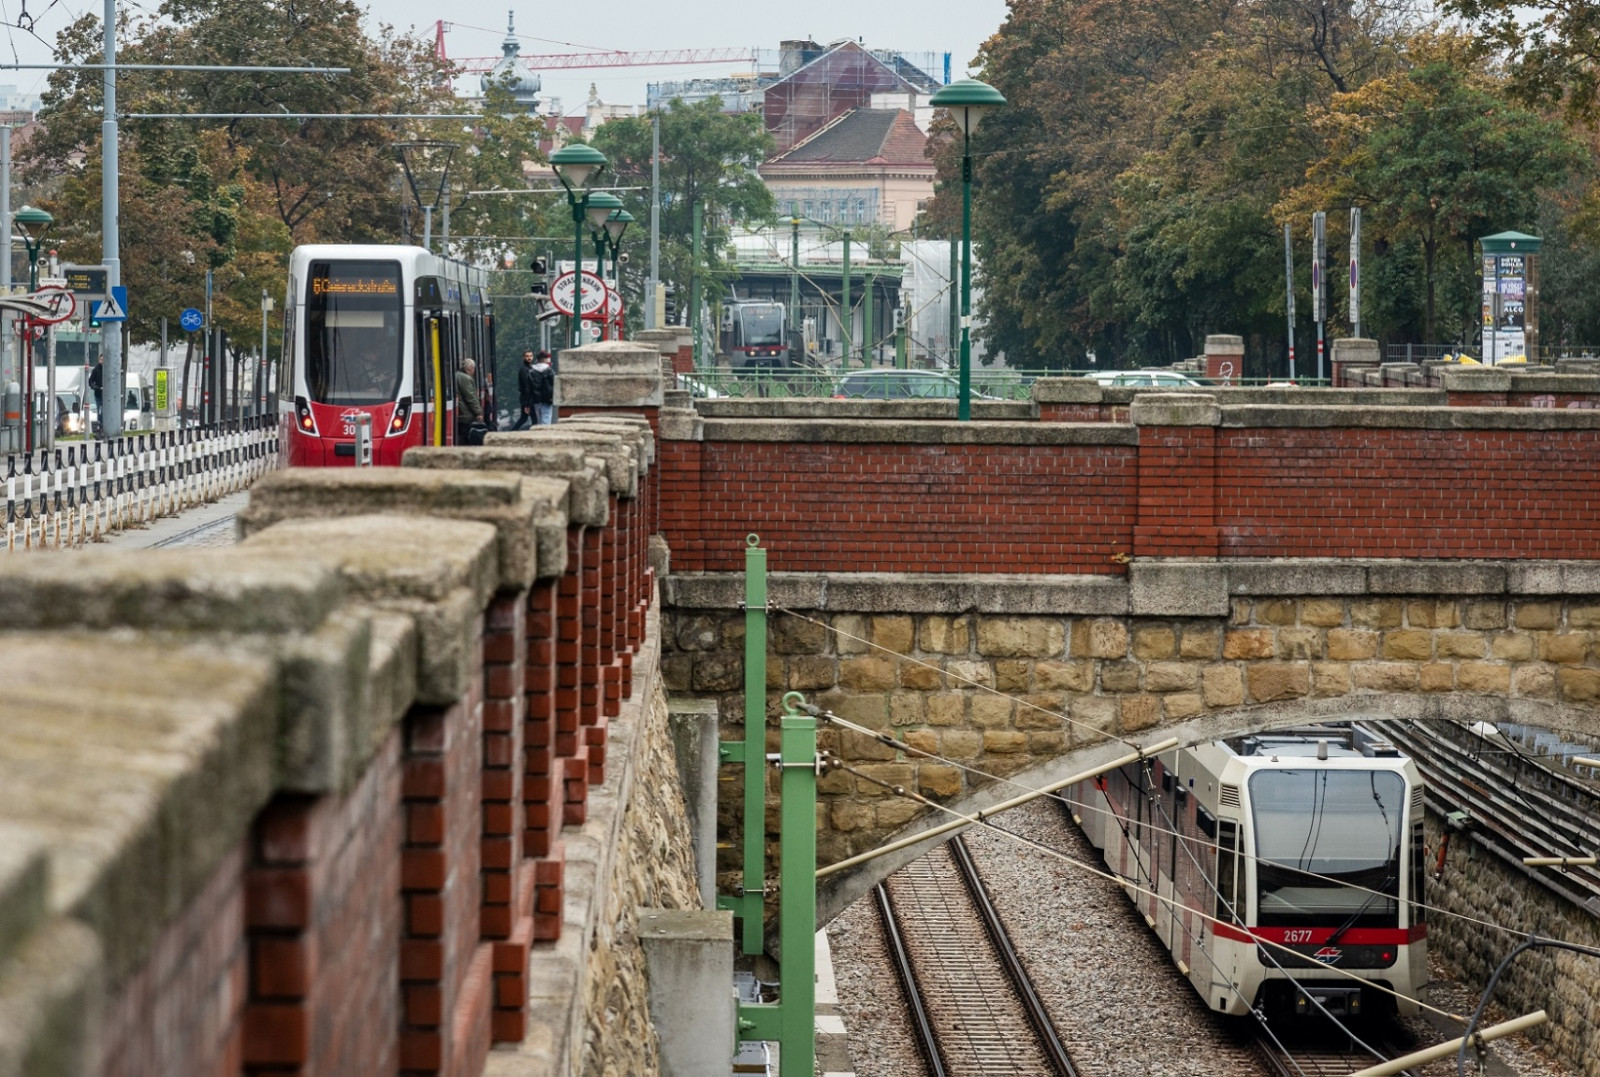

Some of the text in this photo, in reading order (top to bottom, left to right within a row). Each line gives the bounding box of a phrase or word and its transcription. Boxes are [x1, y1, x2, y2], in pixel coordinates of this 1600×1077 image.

[558, 276, 601, 292] STRASNBAHN
[559, 298, 598, 311] HALTTELLE
[343, 424, 356, 435] 30
[1284, 930, 1312, 942] 2677
